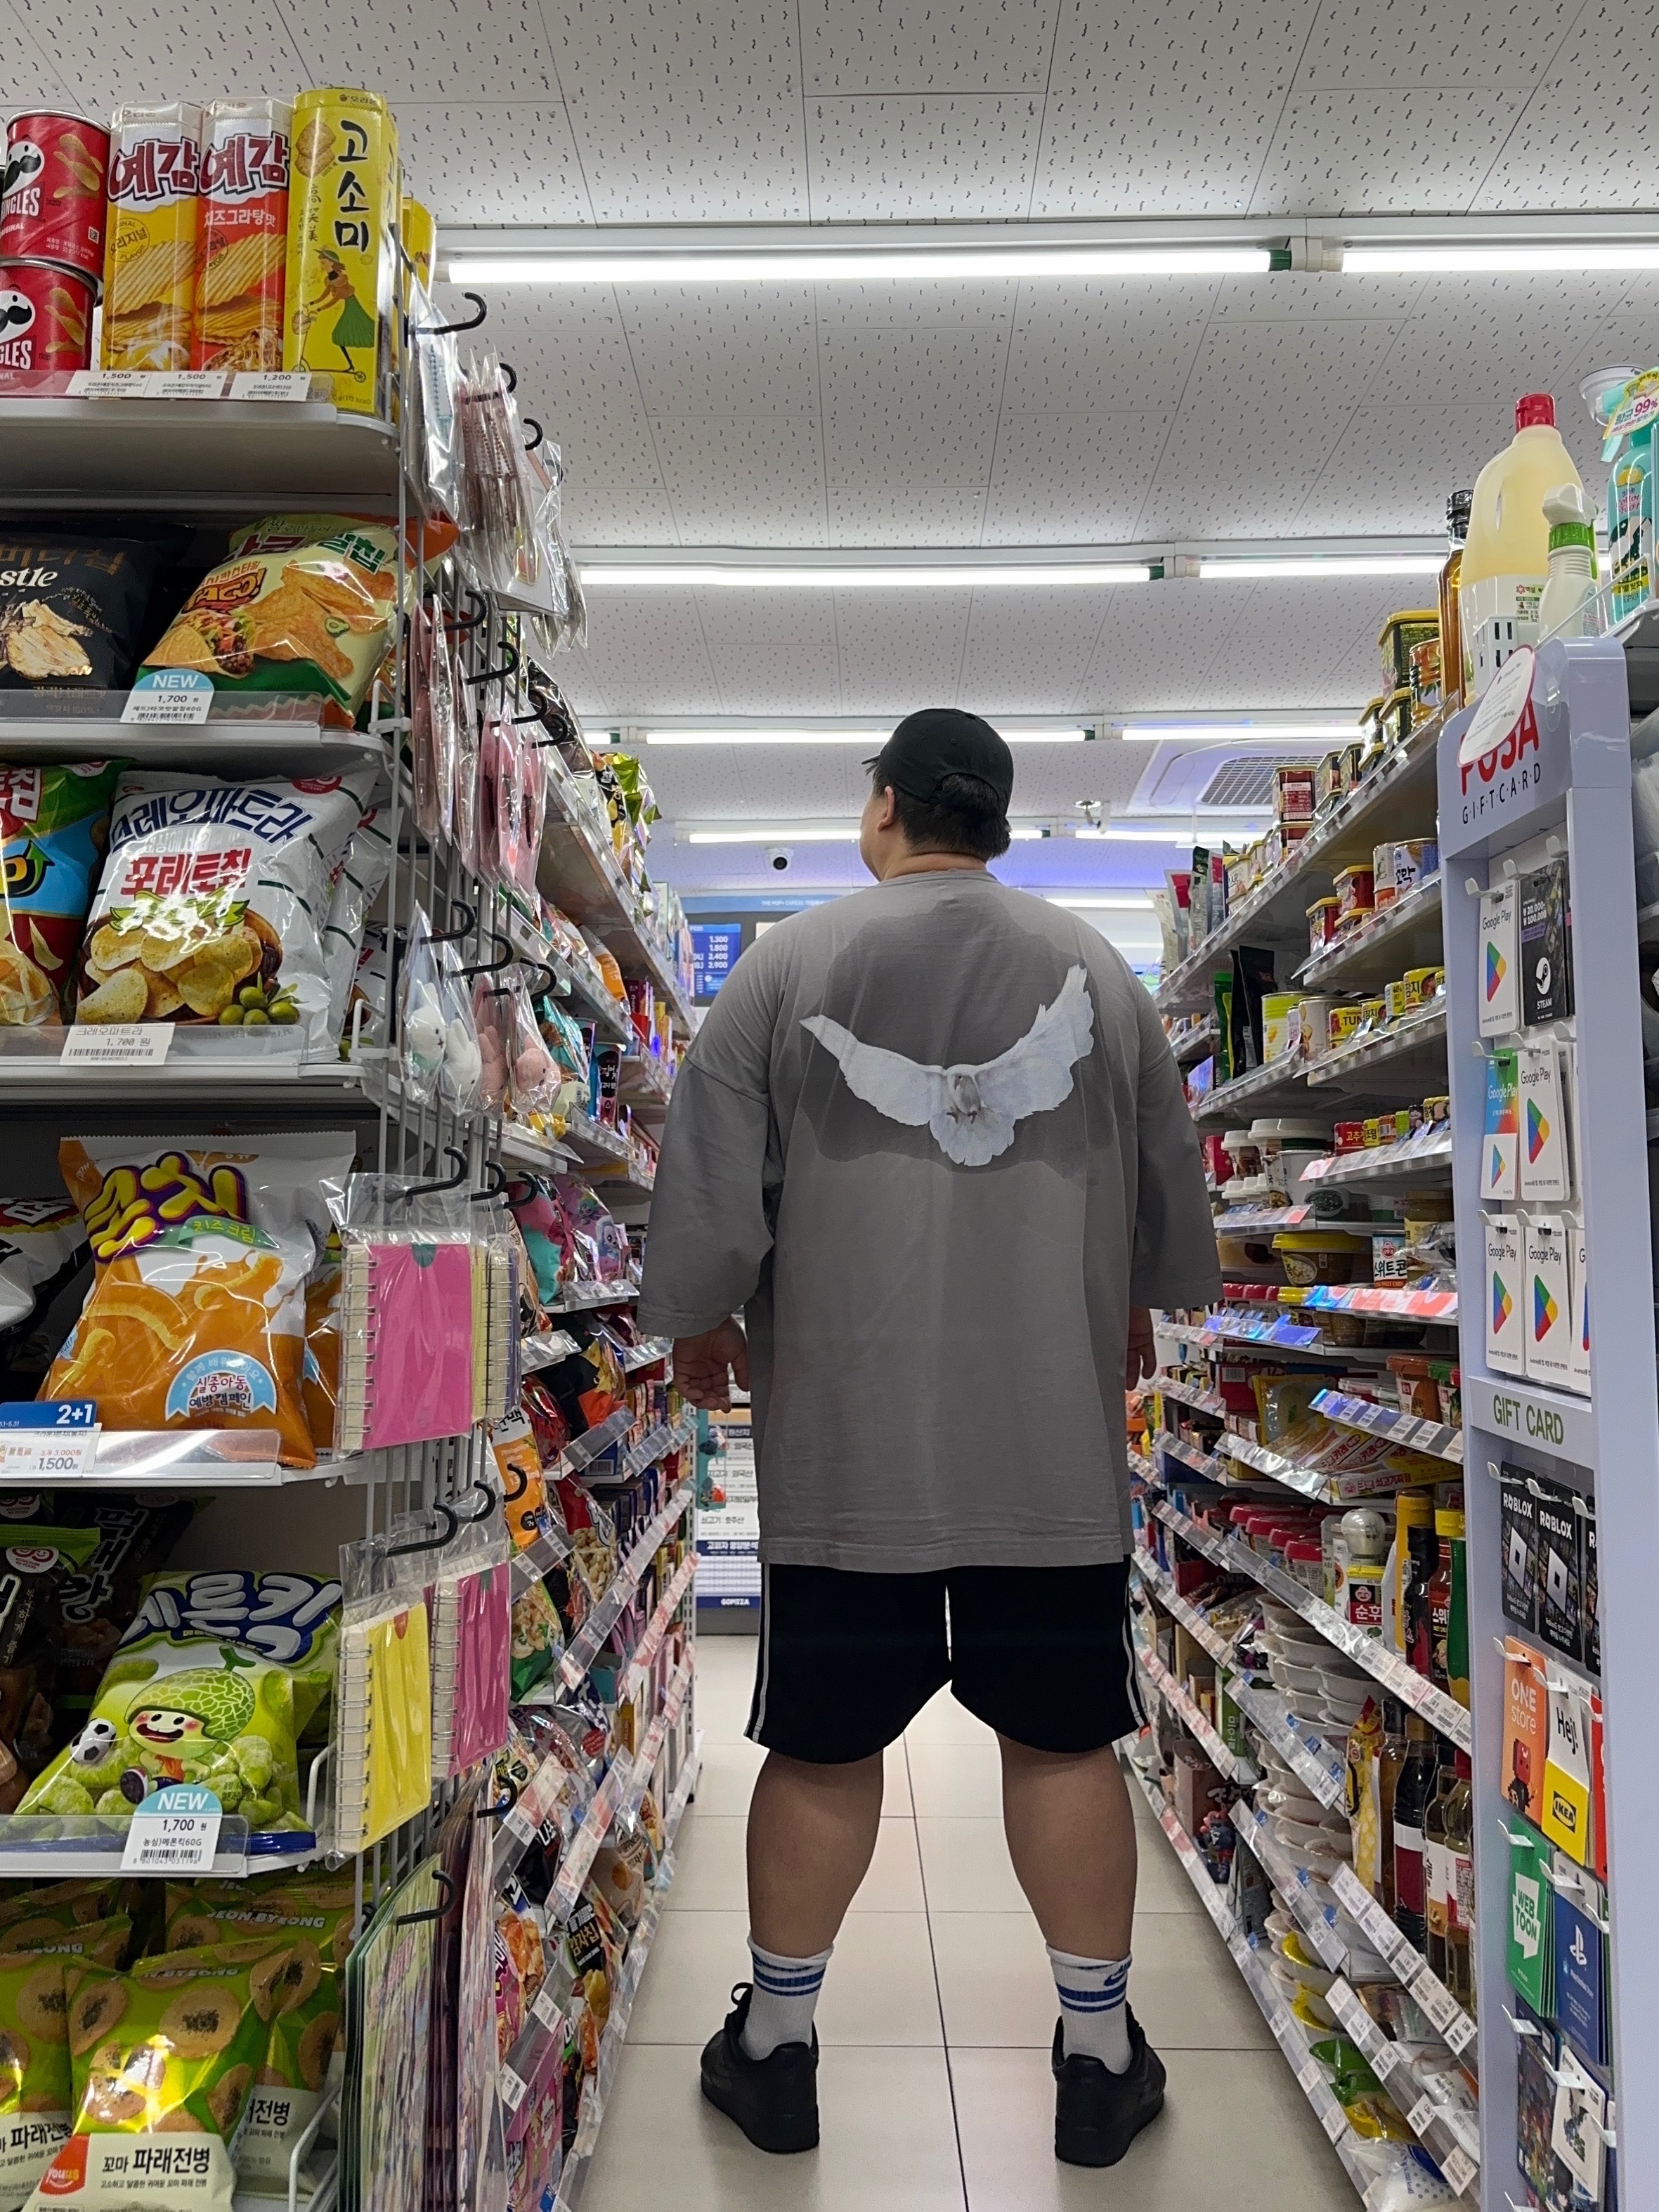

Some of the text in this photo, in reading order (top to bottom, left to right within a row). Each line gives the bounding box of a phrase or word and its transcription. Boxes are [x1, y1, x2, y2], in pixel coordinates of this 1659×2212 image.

[108, 136, 202, 202] 예감
[199, 131, 290, 199] 예감
[204, 209, 276, 228] 치즈그라탕맛
[184, 568, 266, 613] TACO!
[152, 675, 199, 688] NEW
[158, 695, 188, 703] 1,700
[1482, 909, 1511, 930] Google Play
[1537, 998, 1553, 1010] STEAM
[106, 1038, 135, 1047] 1,700
[1521, 1067, 1551, 1087] Google Play
[1488, 1083, 1518, 1102] Google Play
[1488, 1243, 1517, 1262] Google Play
[1528, 1245, 1549, 1264] Google
[1549, 1247, 1562, 1266] Play
[196, 1374, 247, 1393] 실종아동
[56, 1404, 93, 1425] 2+1
[1493, 1393, 1564, 1446] GIFT CARD
[1503, 1492, 1533, 1520] ROBLOX
[1540, 1509, 1573, 1541] ROBLOX
[1511, 1677, 1537, 1714] ONE
[1511, 1703, 1537, 1736] store
[1556, 1706, 1579, 1755] Hej!
[157, 1793, 209, 1811] NEW
[1555, 1799, 1576, 1824] IKEA
[162, 1819, 195, 1833] 1,700
[1517, 1889, 1535, 1918] WEB
[1516, 1906, 1538, 1941] TOON
[102, 2147, 211, 2174] 꼬마 파래전병
